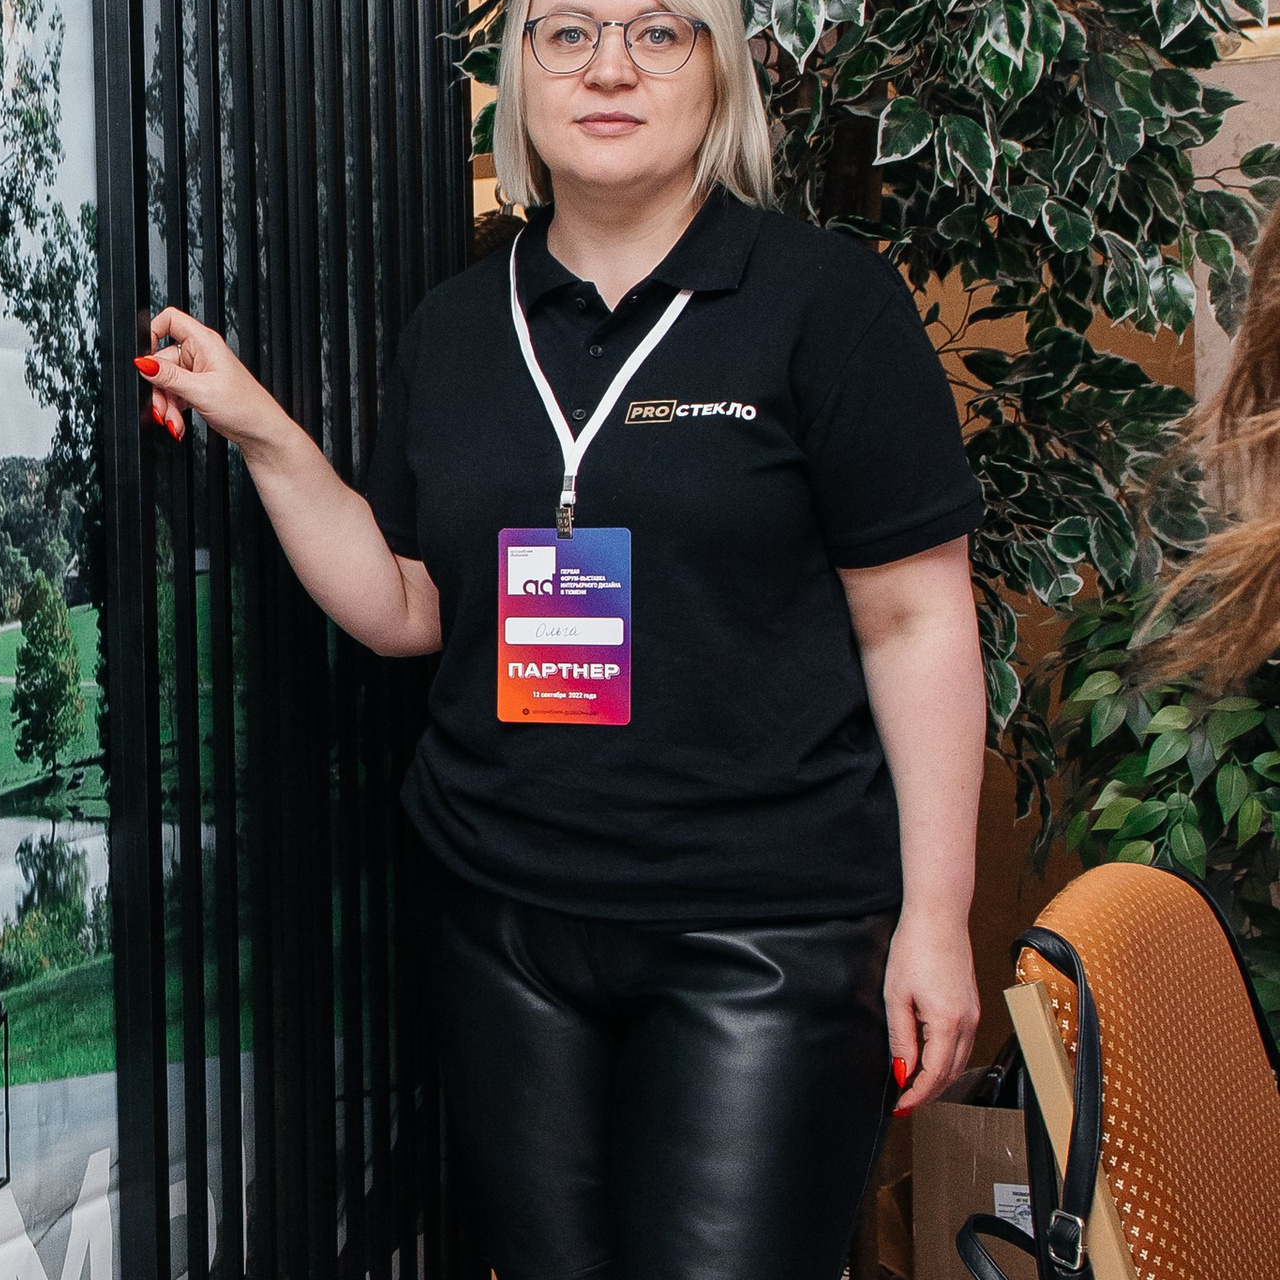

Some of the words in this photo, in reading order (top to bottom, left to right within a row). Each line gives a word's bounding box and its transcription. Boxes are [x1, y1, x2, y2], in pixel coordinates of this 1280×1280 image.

[630, 406, 670, 419] PRO
[675, 401, 757, 421] СТЕКЛО
[535, 622, 582, 638] Ольга
[508, 662, 621, 680] ПАРТНЕР
